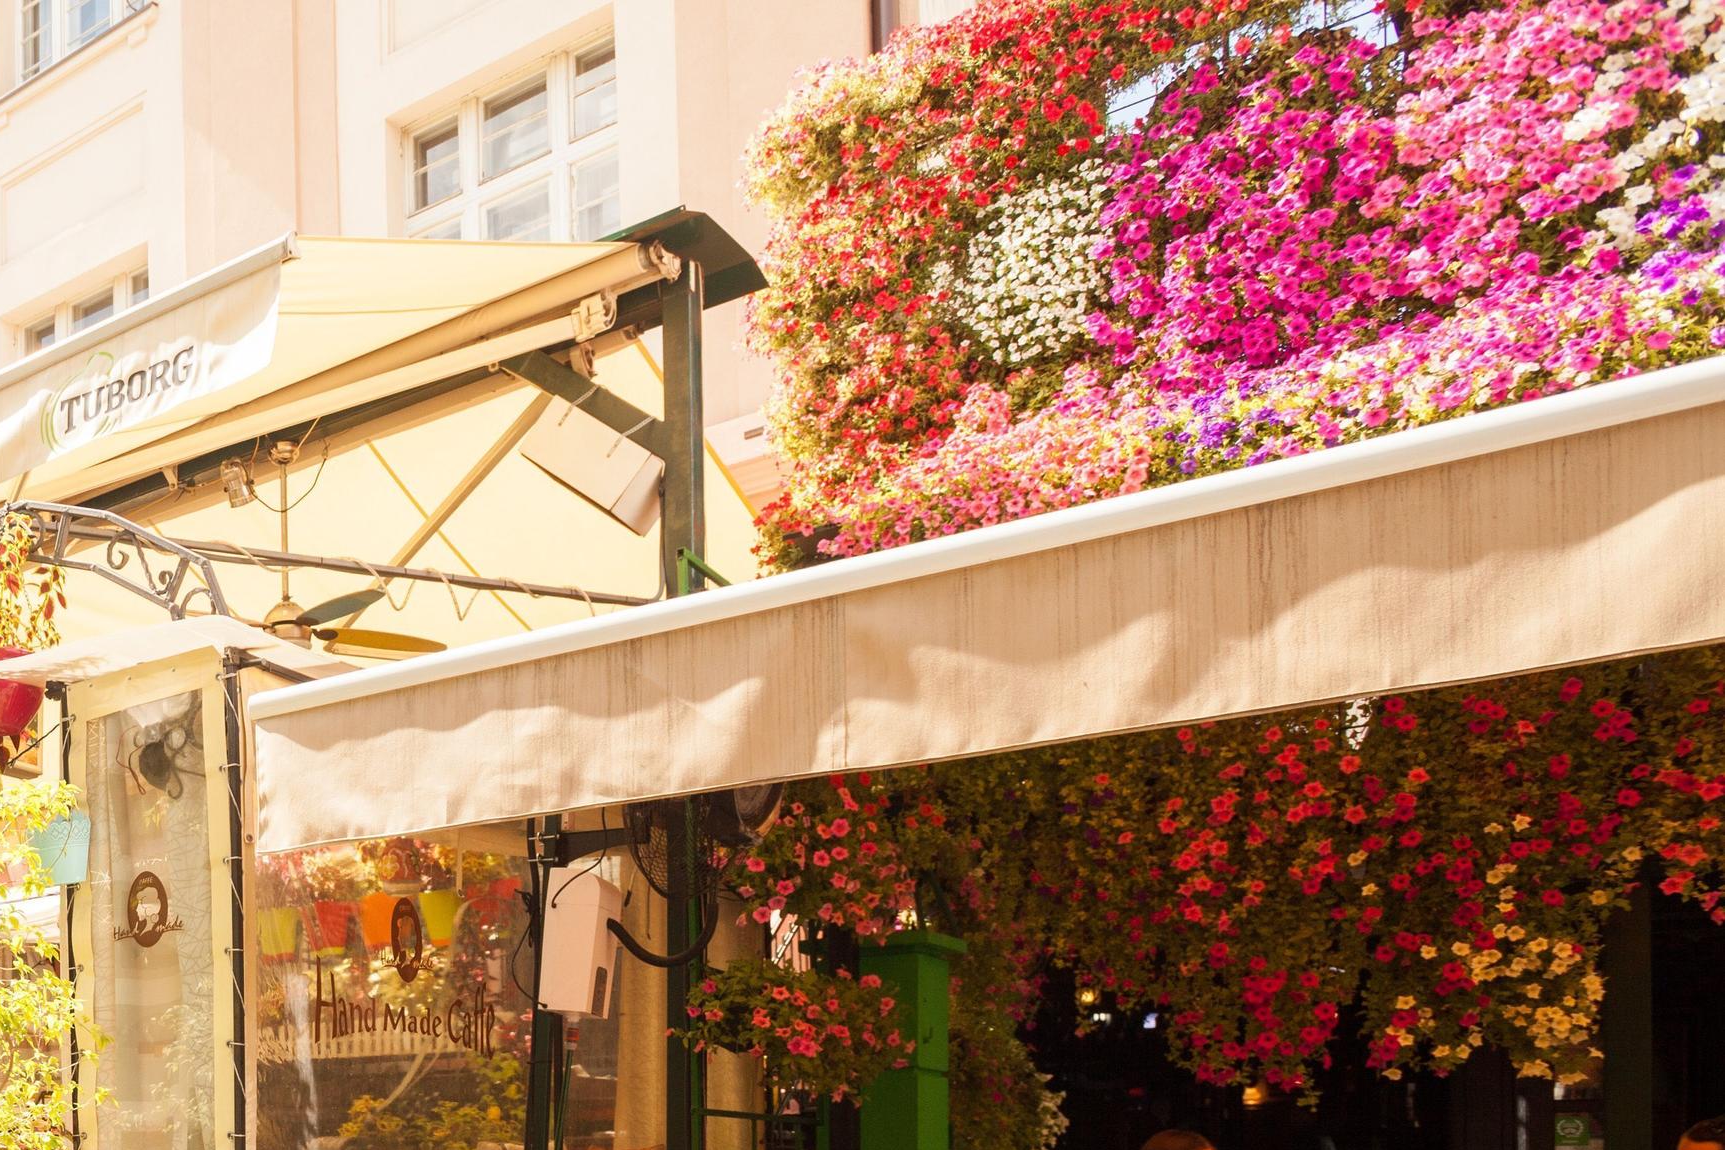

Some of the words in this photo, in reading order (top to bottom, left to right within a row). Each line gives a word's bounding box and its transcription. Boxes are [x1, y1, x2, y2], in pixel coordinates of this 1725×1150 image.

[60, 345, 194, 434] TUBORG
[113, 920, 139, 940] Hand
[155, 914, 184, 933] made
[314, 955, 377, 1045] Hand
[383, 1003, 443, 1038] Made
[448, 981, 496, 1061] Caffe
